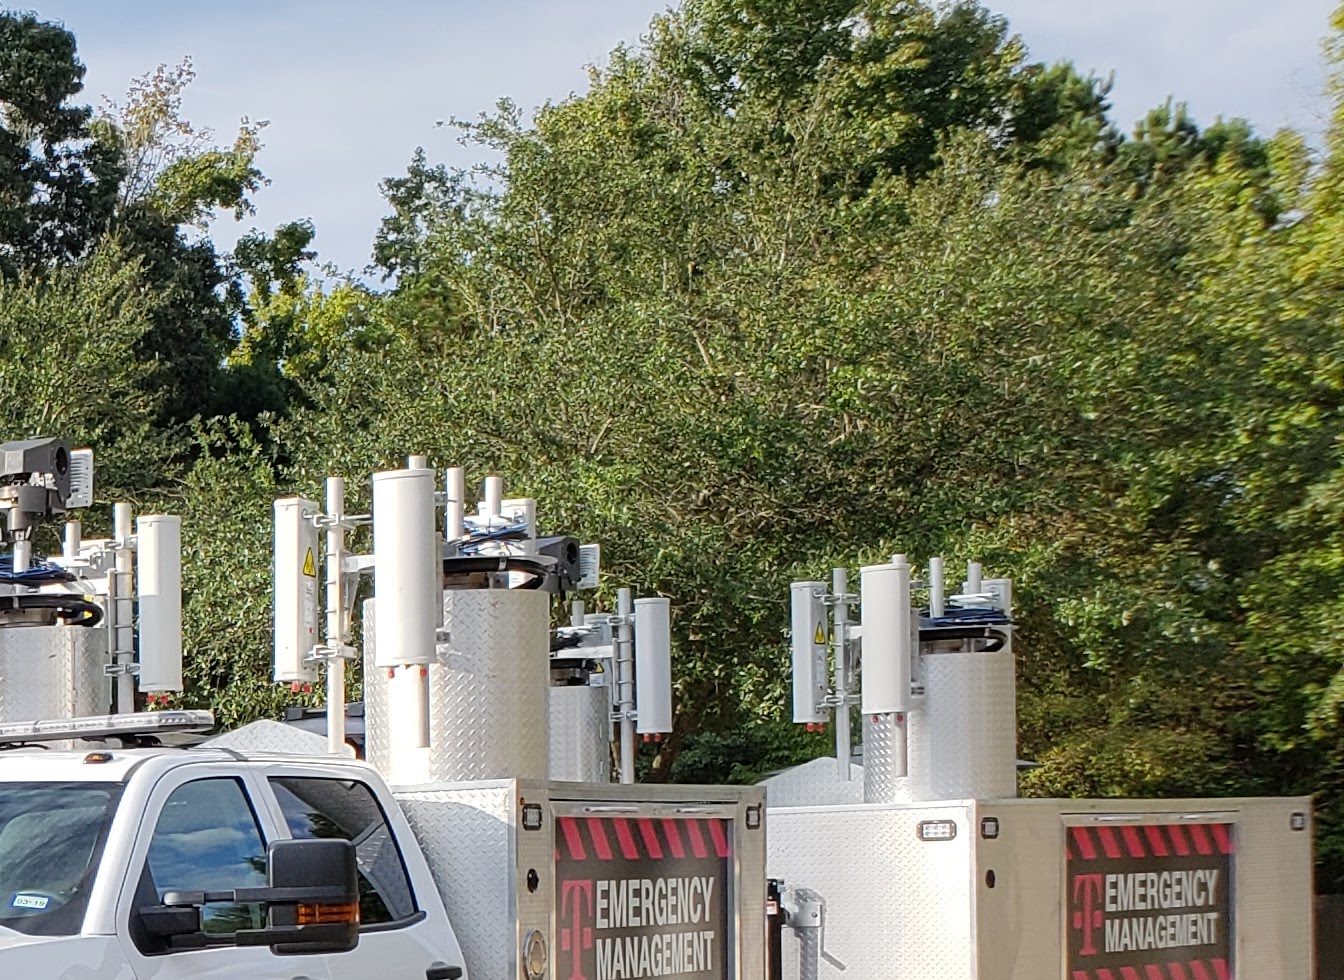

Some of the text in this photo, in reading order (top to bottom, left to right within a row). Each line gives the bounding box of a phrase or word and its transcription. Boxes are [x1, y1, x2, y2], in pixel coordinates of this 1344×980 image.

[596, 876, 714, 929] EMERGENCY
[1105, 869, 1218, 912] EMERGENCY
[1105, 912, 1218, 953] MANAGEMENT
